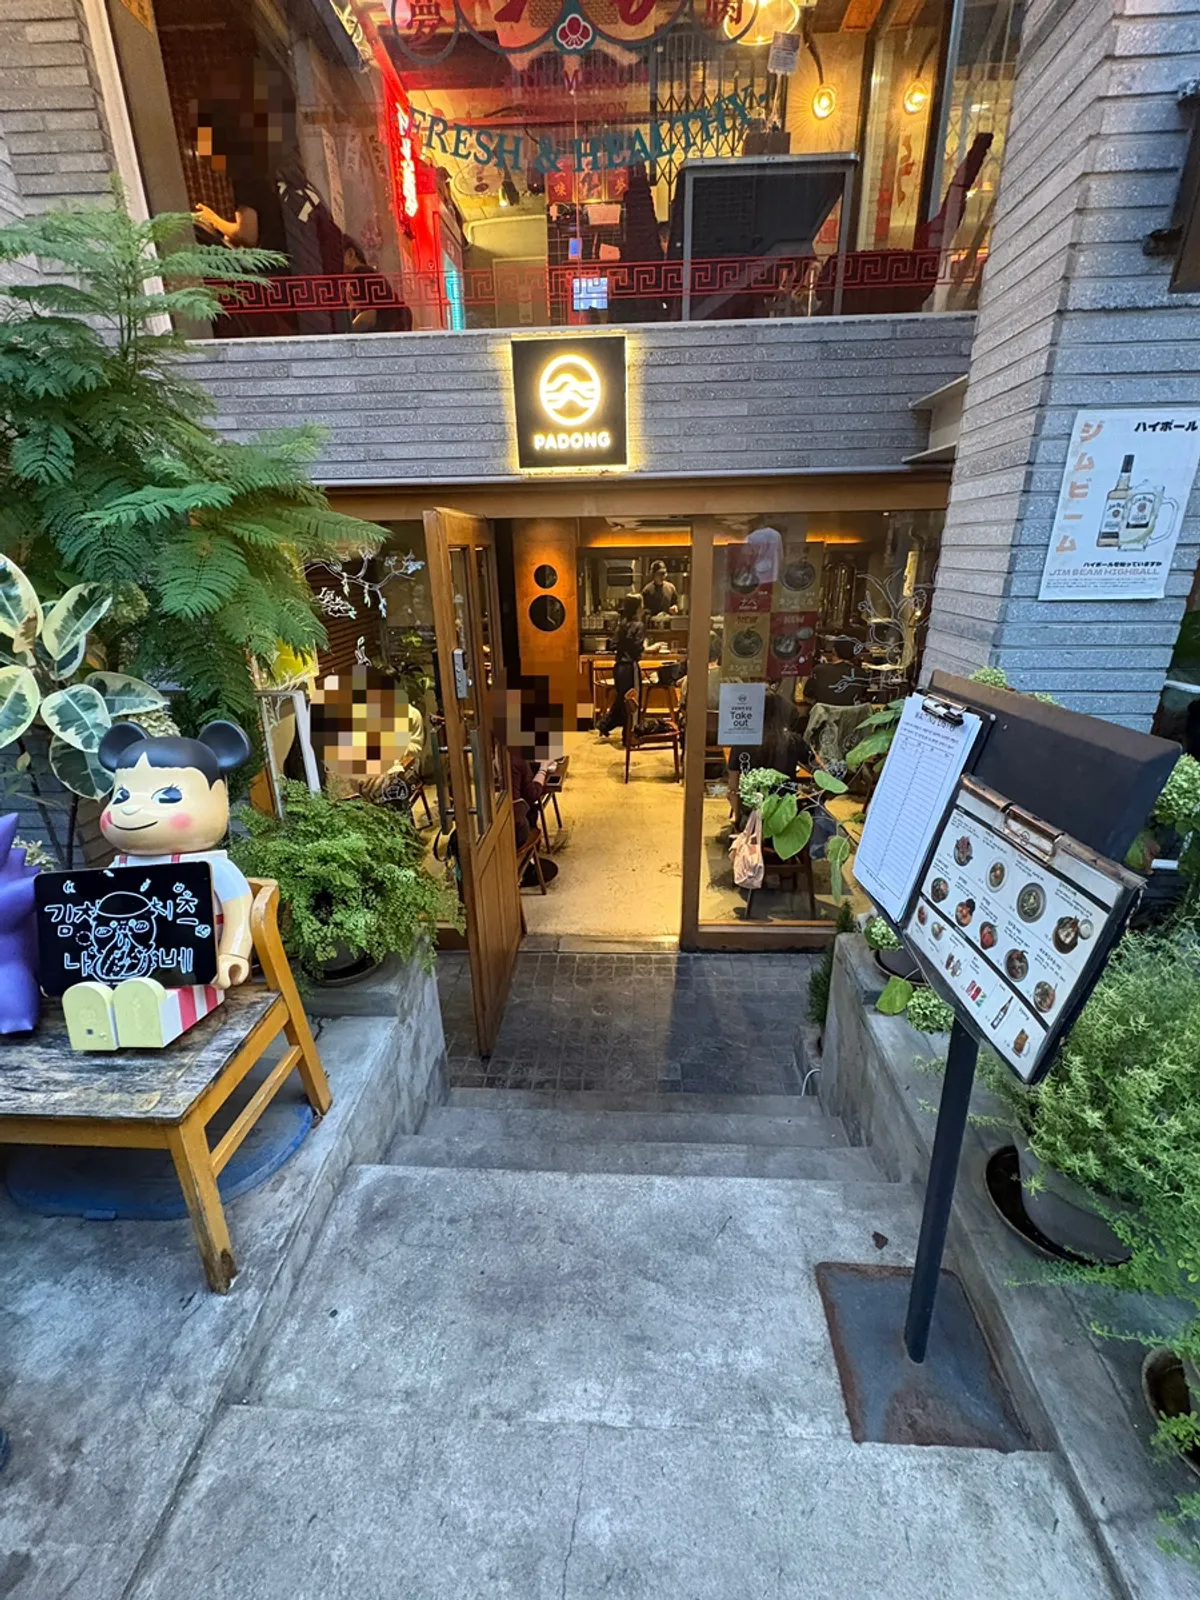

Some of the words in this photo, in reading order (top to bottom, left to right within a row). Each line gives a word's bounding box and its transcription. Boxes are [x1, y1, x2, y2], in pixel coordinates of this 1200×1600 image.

[408, 105, 524, 169] FRESH
[535, 136, 562, 174] &
[573, 85, 754, 172] HEALTHY
[1134, 419, 1198, 432] ハイボール
[534, 432, 610, 450] PADONG
[1056, 420, 1105, 553] ジムビーム
[1049, 568, 1071, 577] JIM
[1072, 568, 1103, 576] BEAM
[1103, 567, 1160, 576] HIGHBALL
[730, 711, 753, 720] Take
[733, 719, 749, 727] out
